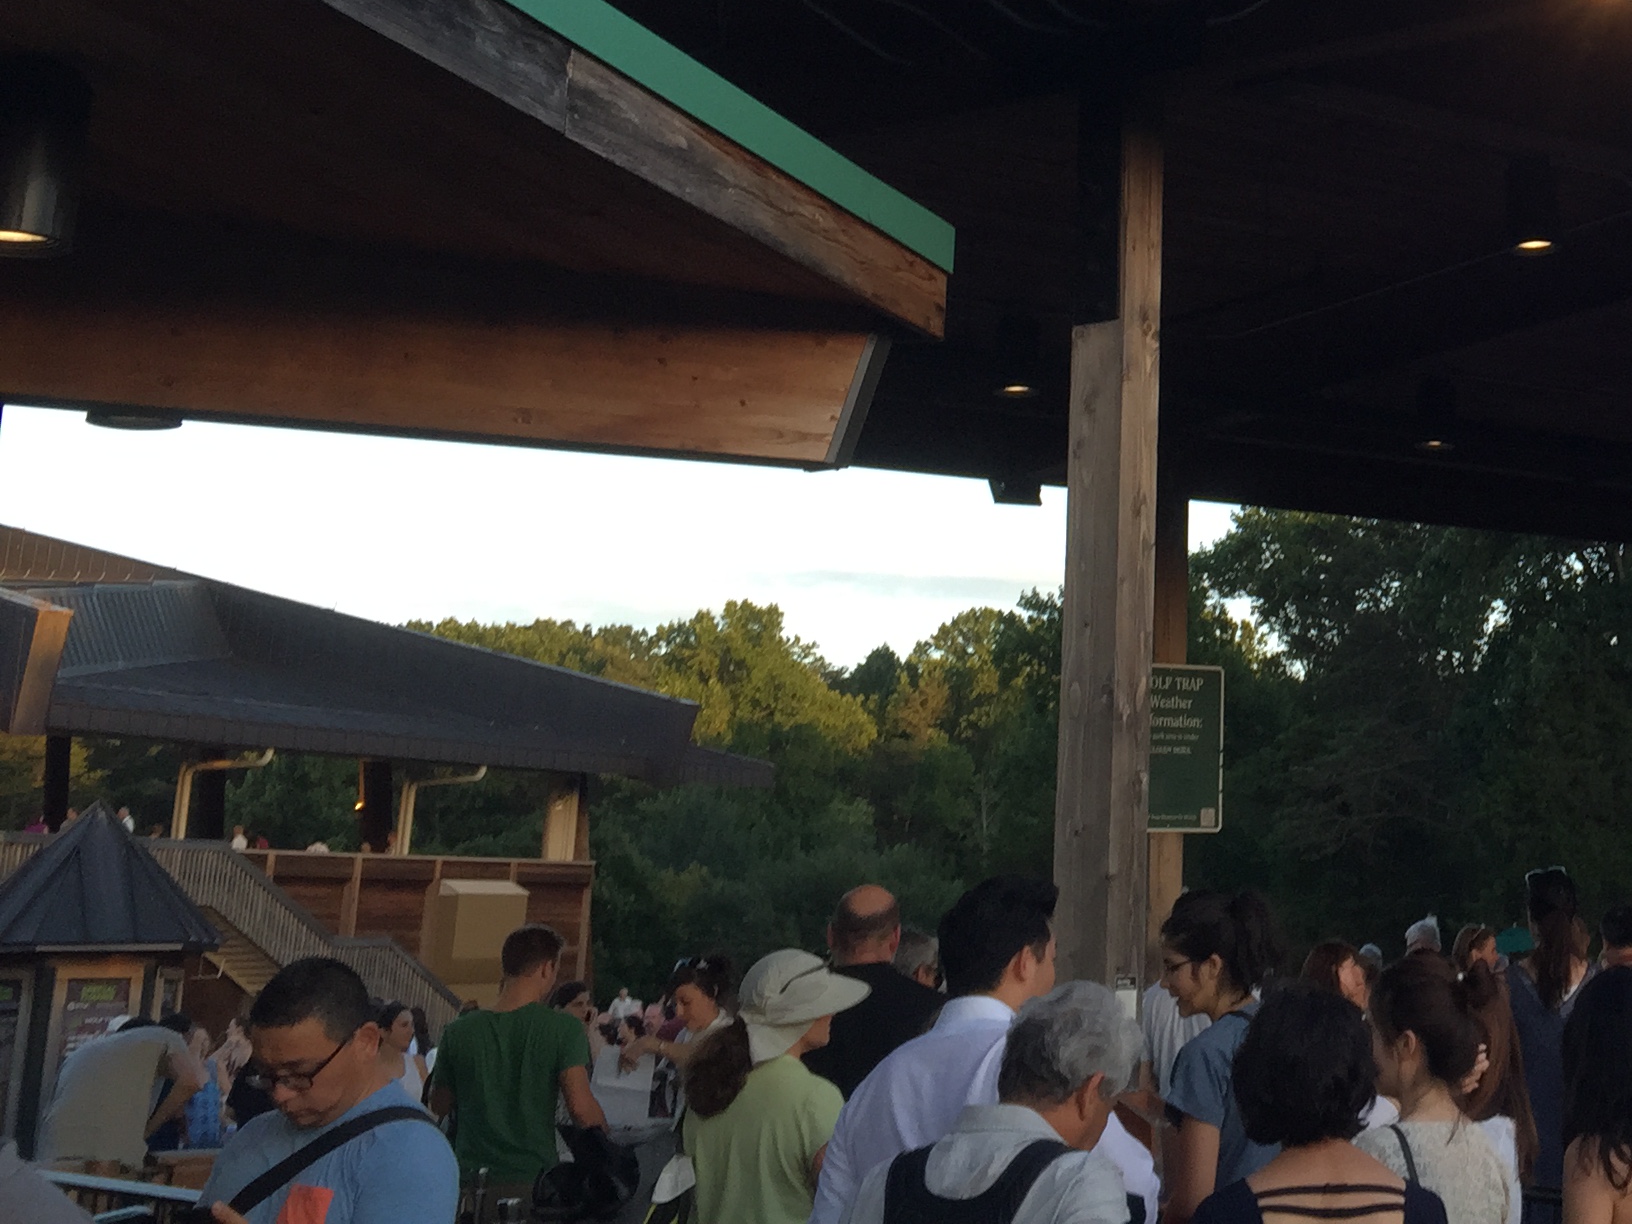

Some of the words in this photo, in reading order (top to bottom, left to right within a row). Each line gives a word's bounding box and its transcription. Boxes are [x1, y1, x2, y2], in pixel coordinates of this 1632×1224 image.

[1150, 676, 1173, 690] OLF
[1175, 677, 1204, 691] TRAP
[1150, 693, 1193, 710] Weather
[1149, 712, 1203, 729] formation:
